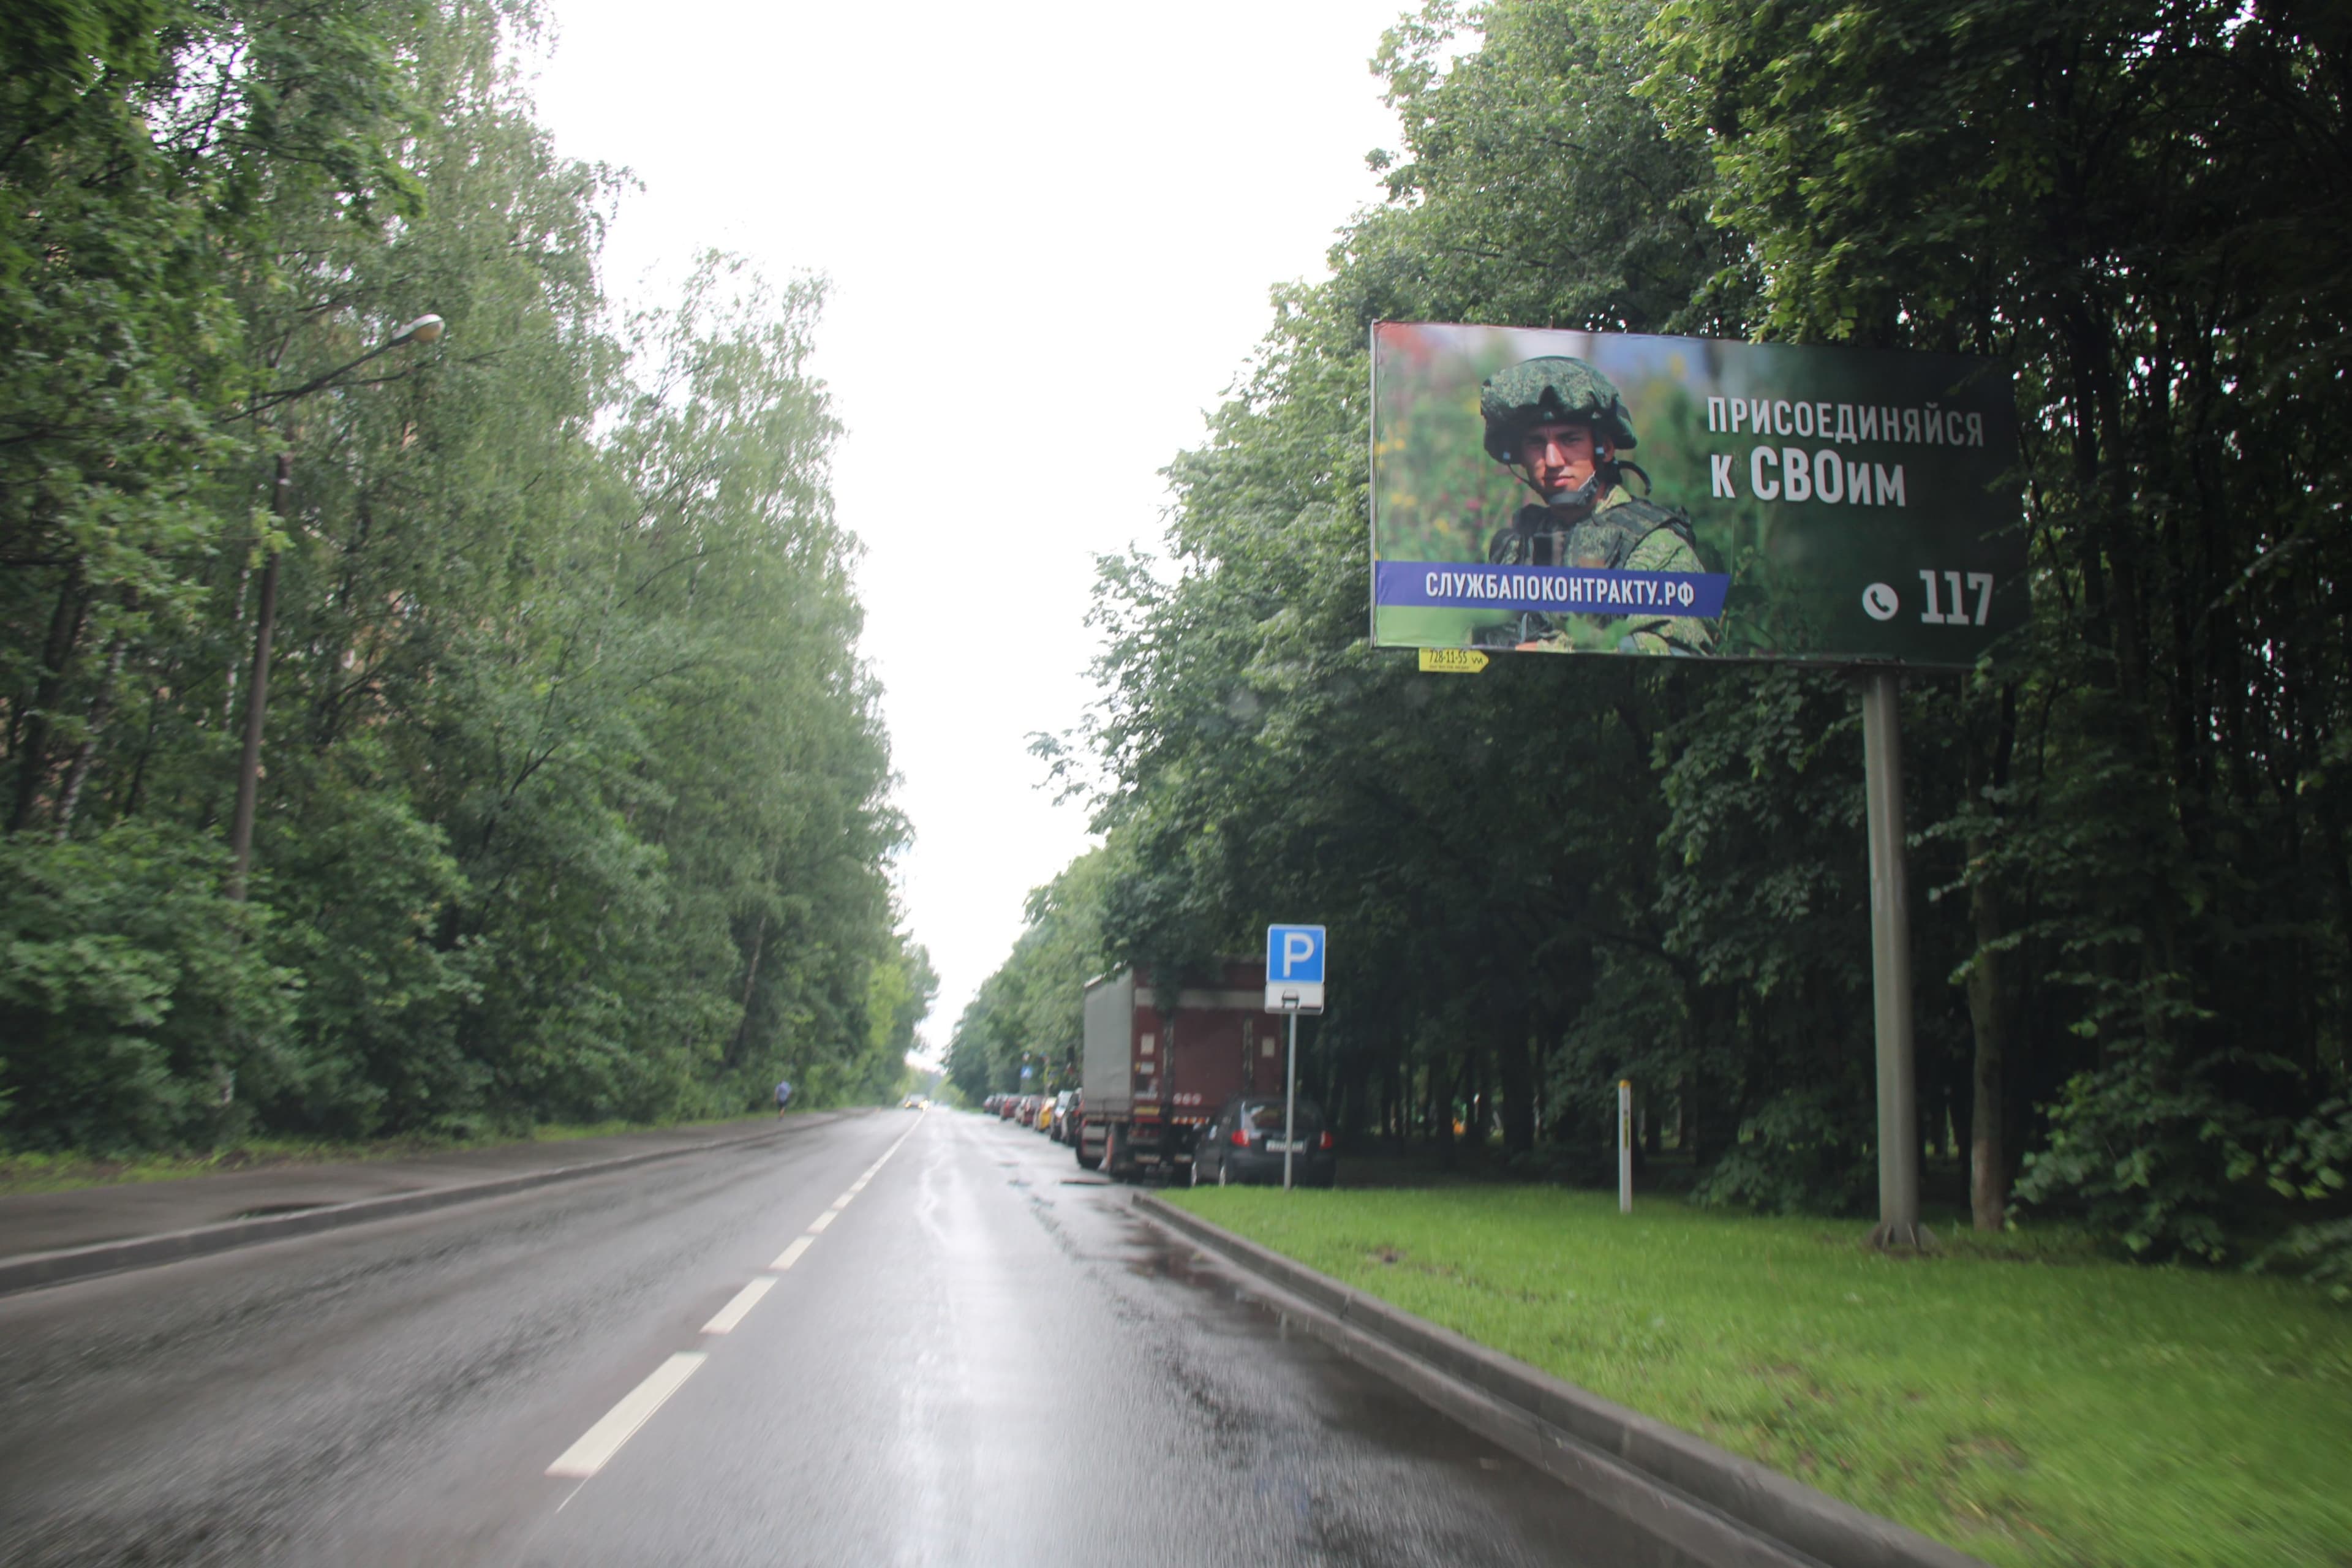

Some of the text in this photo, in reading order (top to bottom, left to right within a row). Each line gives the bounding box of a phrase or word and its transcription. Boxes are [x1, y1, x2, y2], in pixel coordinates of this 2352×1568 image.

[1708, 397, 1983, 447] ПРИСОЕДИНЯЙСЯ
[1426, 571, 1694, 607] СЛУЖБАПОКОНТРАКТУ.РФ
[1919, 569, 1994, 625] 117
[1430, 650, 1467, 663] 728-11-55
[1283, 933, 1314, 978] P
